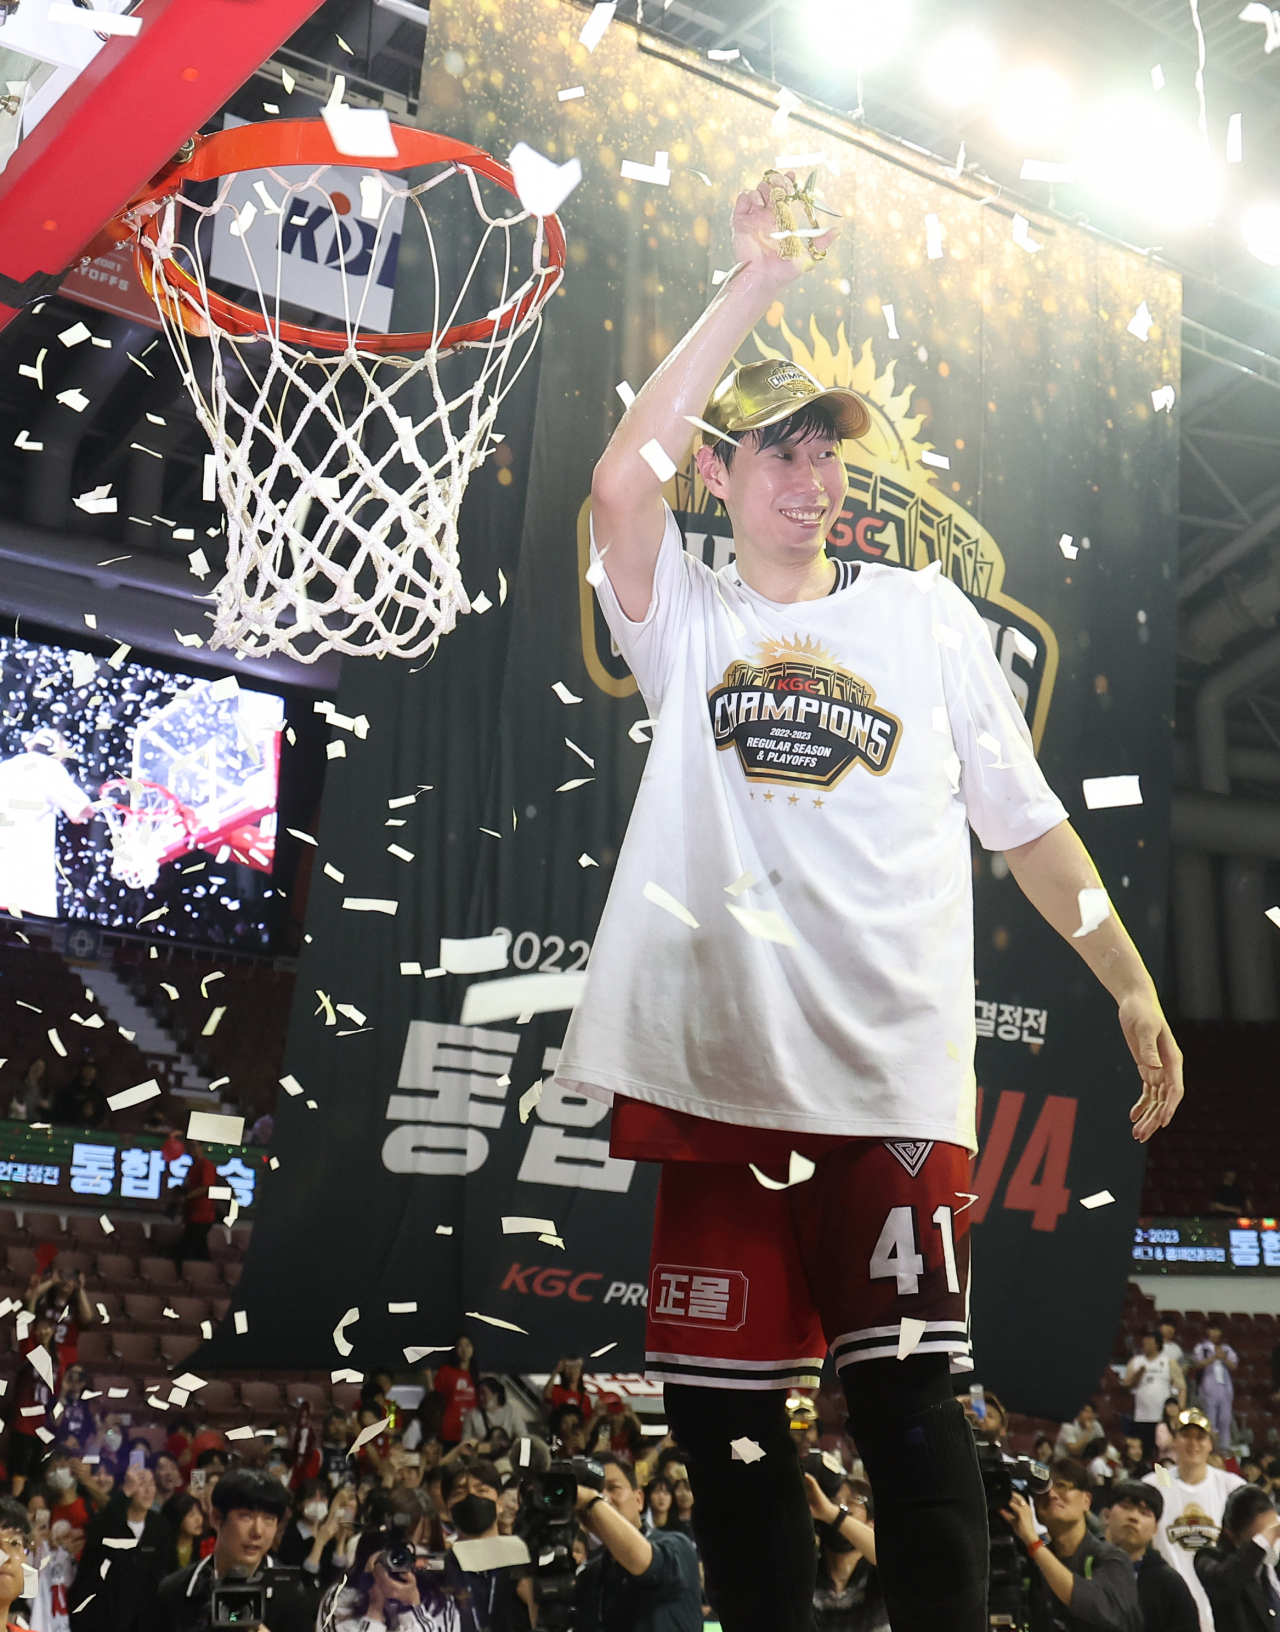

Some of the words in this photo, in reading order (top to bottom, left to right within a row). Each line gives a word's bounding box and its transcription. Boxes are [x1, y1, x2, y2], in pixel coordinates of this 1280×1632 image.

[827, 509, 885, 557] GC
[777, 676, 819, 695] KGC
[714, 691, 892, 767] CHAMPIONS
[746, 736, 791, 753] REGULAR
[791, 742, 833, 758] SEASON
[769, 727, 812, 741] 2022-2023
[756, 750, 764, 761] &
[766, 751, 818, 768] PLAYOFFS
[869, 1205, 961, 1295] 41
[501, 1263, 604, 1302] KGC
[603, 1281, 649, 1307] PR
[655, 1272, 730, 1321] 正몰
